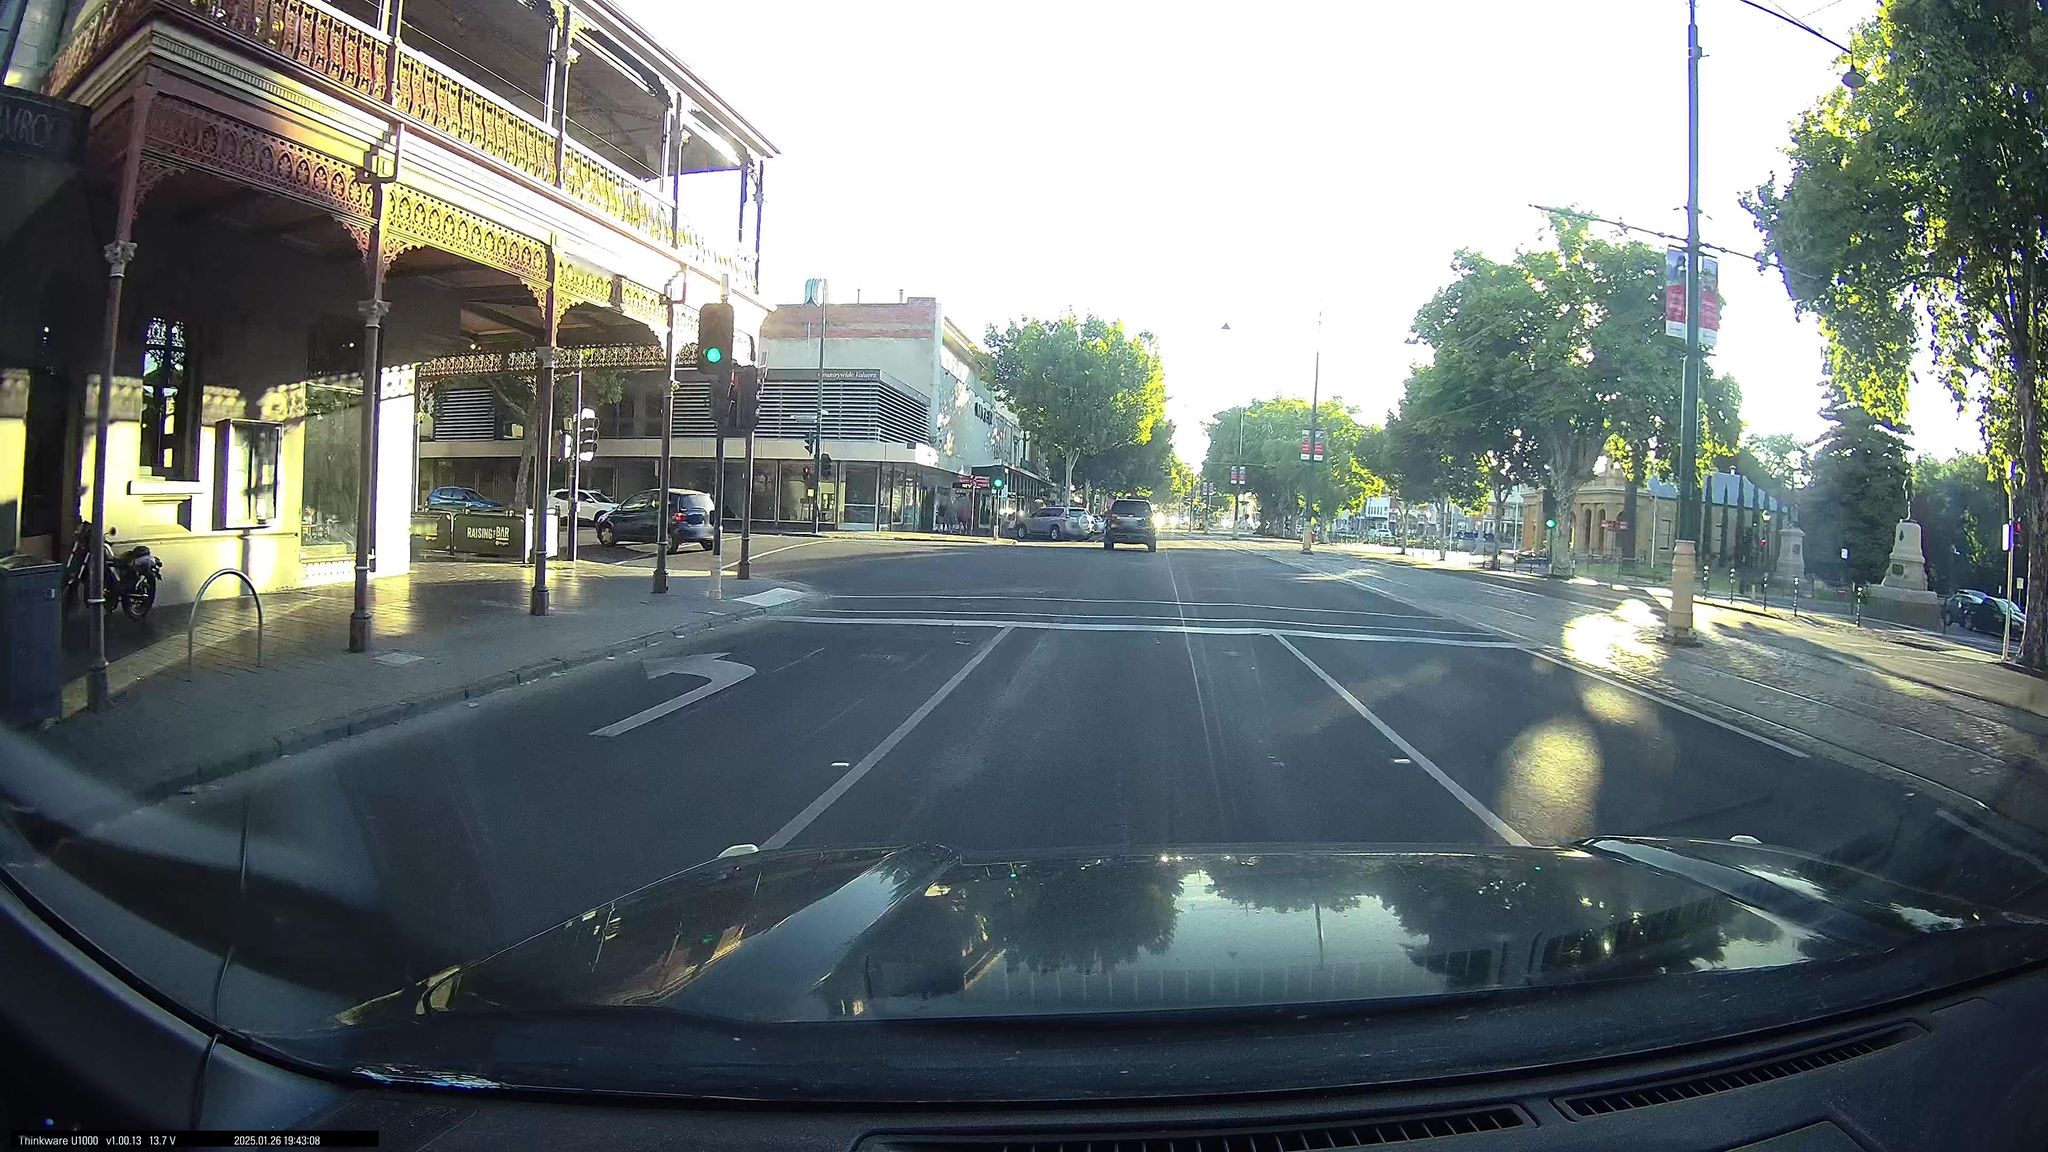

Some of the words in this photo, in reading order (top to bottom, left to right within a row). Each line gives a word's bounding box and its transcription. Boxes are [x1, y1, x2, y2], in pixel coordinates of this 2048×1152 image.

[0, 105, 50, 146] URO
[467, 526, 493, 539] RAISING
[496, 526, 510, 538] BAR
